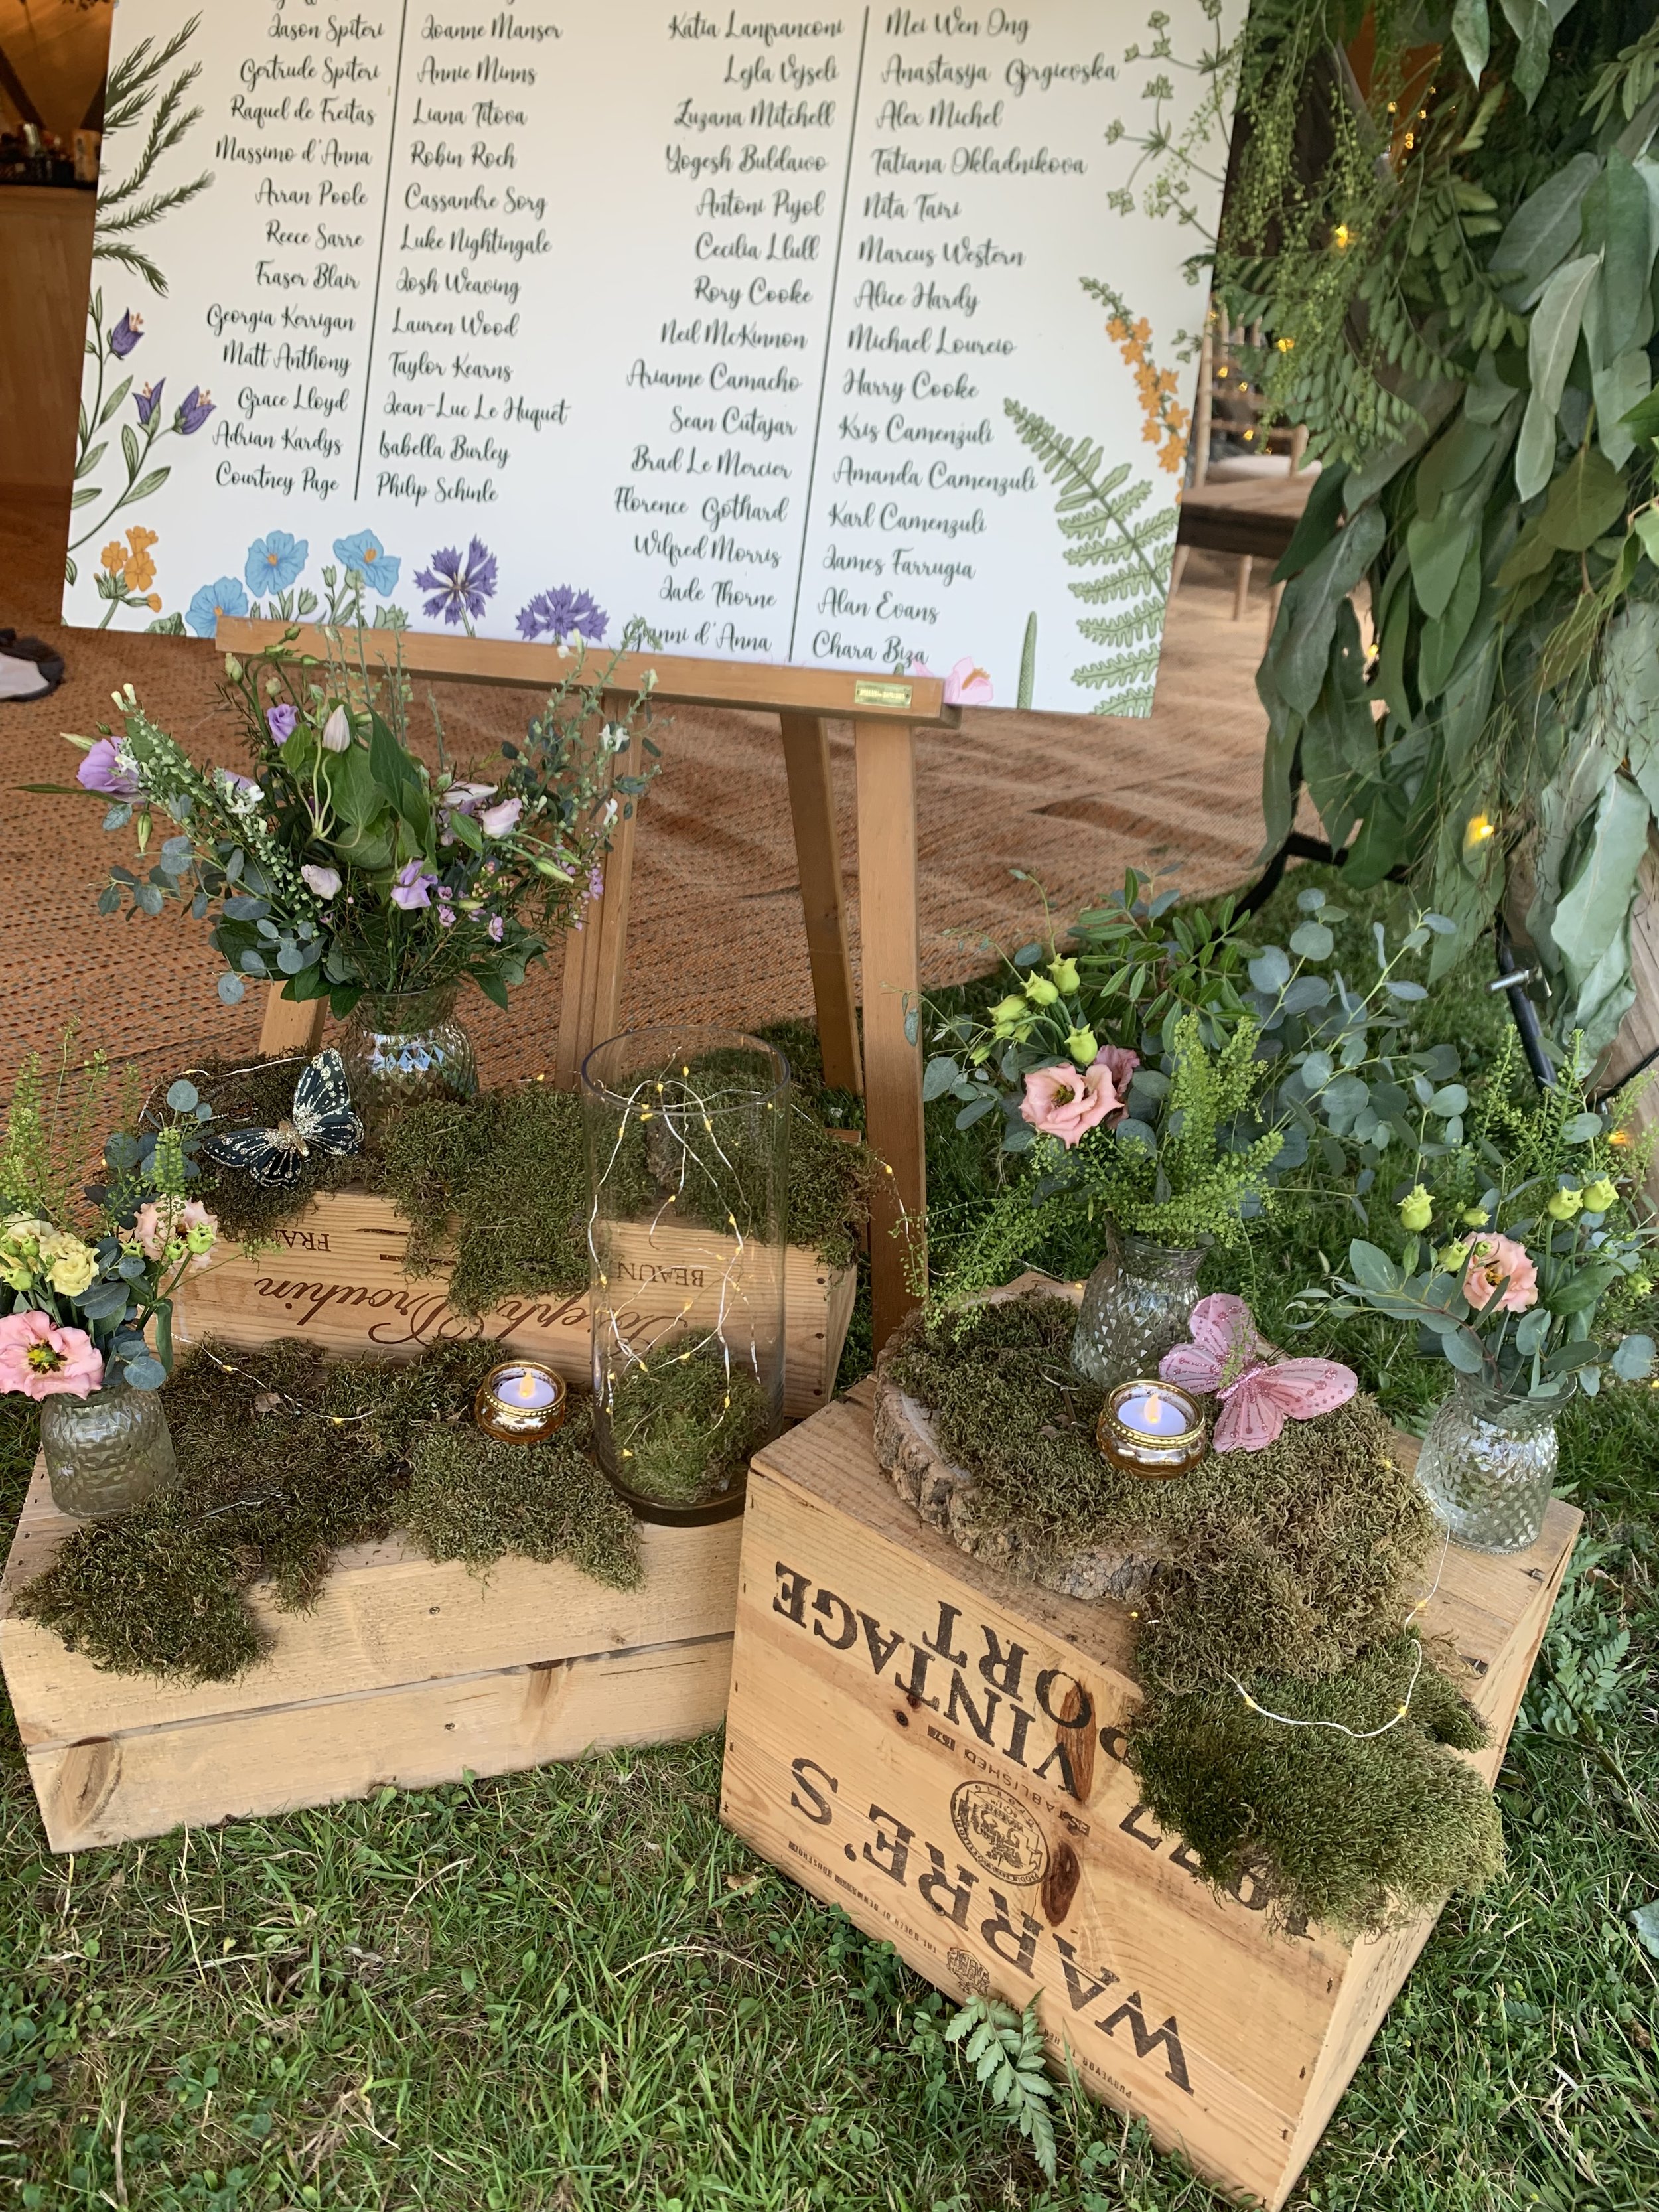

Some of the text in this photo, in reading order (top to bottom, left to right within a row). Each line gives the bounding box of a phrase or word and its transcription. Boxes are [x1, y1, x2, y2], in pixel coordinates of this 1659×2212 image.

[267, 13, 385, 48] Jason Spiteri
[421, 11, 563, 43] Joanne Manser
[668, 9, 843, 48] Katia Lanfranconi
[885, 5, 1029, 45] Mei Wen Ong
[239, 54, 380, 94] Gertrude Spiteri
[417, 54, 538, 86] Annie Minns
[230, 94, 377, 130] Raquel de Freitas
[412, 96, 528, 129] Liana Titova
[749, 98, 837, 129] Mitchell
[875, 98, 1005, 131] Alex Michel
[215, 133, 373, 168] Massimo d'Anna
[410, 139, 517, 170] Robin Roch
[665, 143, 731, 181] Yogesh
[871, 145, 1085, 177] Tatiana Okladnikova
[254, 177, 368, 207] Arran Poole
[404, 182, 547, 222] Cassandre Sorg
[695, 187, 826, 224] Antoni Pujol
[863, 190, 909, 220] Nita
[265, 218, 364, 250] Reece Sarre
[399, 223, 553, 263] Luke Nightingale
[694, 231, 821, 261] Cecilia Llull
[857, 234, 1023, 269] Marcus Western
[255, 259, 360, 290] Fraser Blair
[396, 266, 522, 305] Josh Weaving
[694, 275, 814, 311] Rory Cooke
[854, 279, 979, 318] Alice Hardy
[206, 303, 356, 339] Georgia Kerrigan
[391, 306, 520, 338] Lauren Wood
[660, 318, 808, 350] Neil McKinnon
[847, 323, 933, 354] Michael
[222, 338, 352, 378] Matt Anthony
[388, 350, 514, 383] Taylor Kearns
[626, 358, 803, 393] Arianne Camacho
[237, 383, 350, 421] Grace Lloyd
[842, 367, 979, 404] Harry Cooke
[383, 390, 470, 419] Jean-Luc
[474, 392, 499, 421] Le
[670, 405, 798, 443] Sean Cutajar
[212, 419, 344, 459] Adrian Kardys
[378, 429, 511, 470] Isabella Burley
[838, 412, 995, 451] Kris Camenzuli
[215, 459, 340, 501] Courtney Page
[630, 444, 793, 480] Brad Le Mercier
[833, 455, 1039, 497] Amanda Camenzuli
[376, 471, 429, 508] Philip
[614, 485, 790, 533] Florence Gothard
[828, 500, 987, 540] Karl Camenzuli
[634, 529, 782, 569] Wilfred Morris
[822, 544, 977, 587] James Farrugia
[659, 575, 778, 609] Jade Thorne
[818, 586, 940, 625] Alan Evans
[624, 619, 772, 653] Ganni d'Anna
[812, 630, 930, 668] Chara Biza
[774, 1561, 1083, 1802] VINTAGE
[962, 1747, 1091, 1838] ESTABLISHED
[790, 1758, 1194, 2095] WARRE'S
